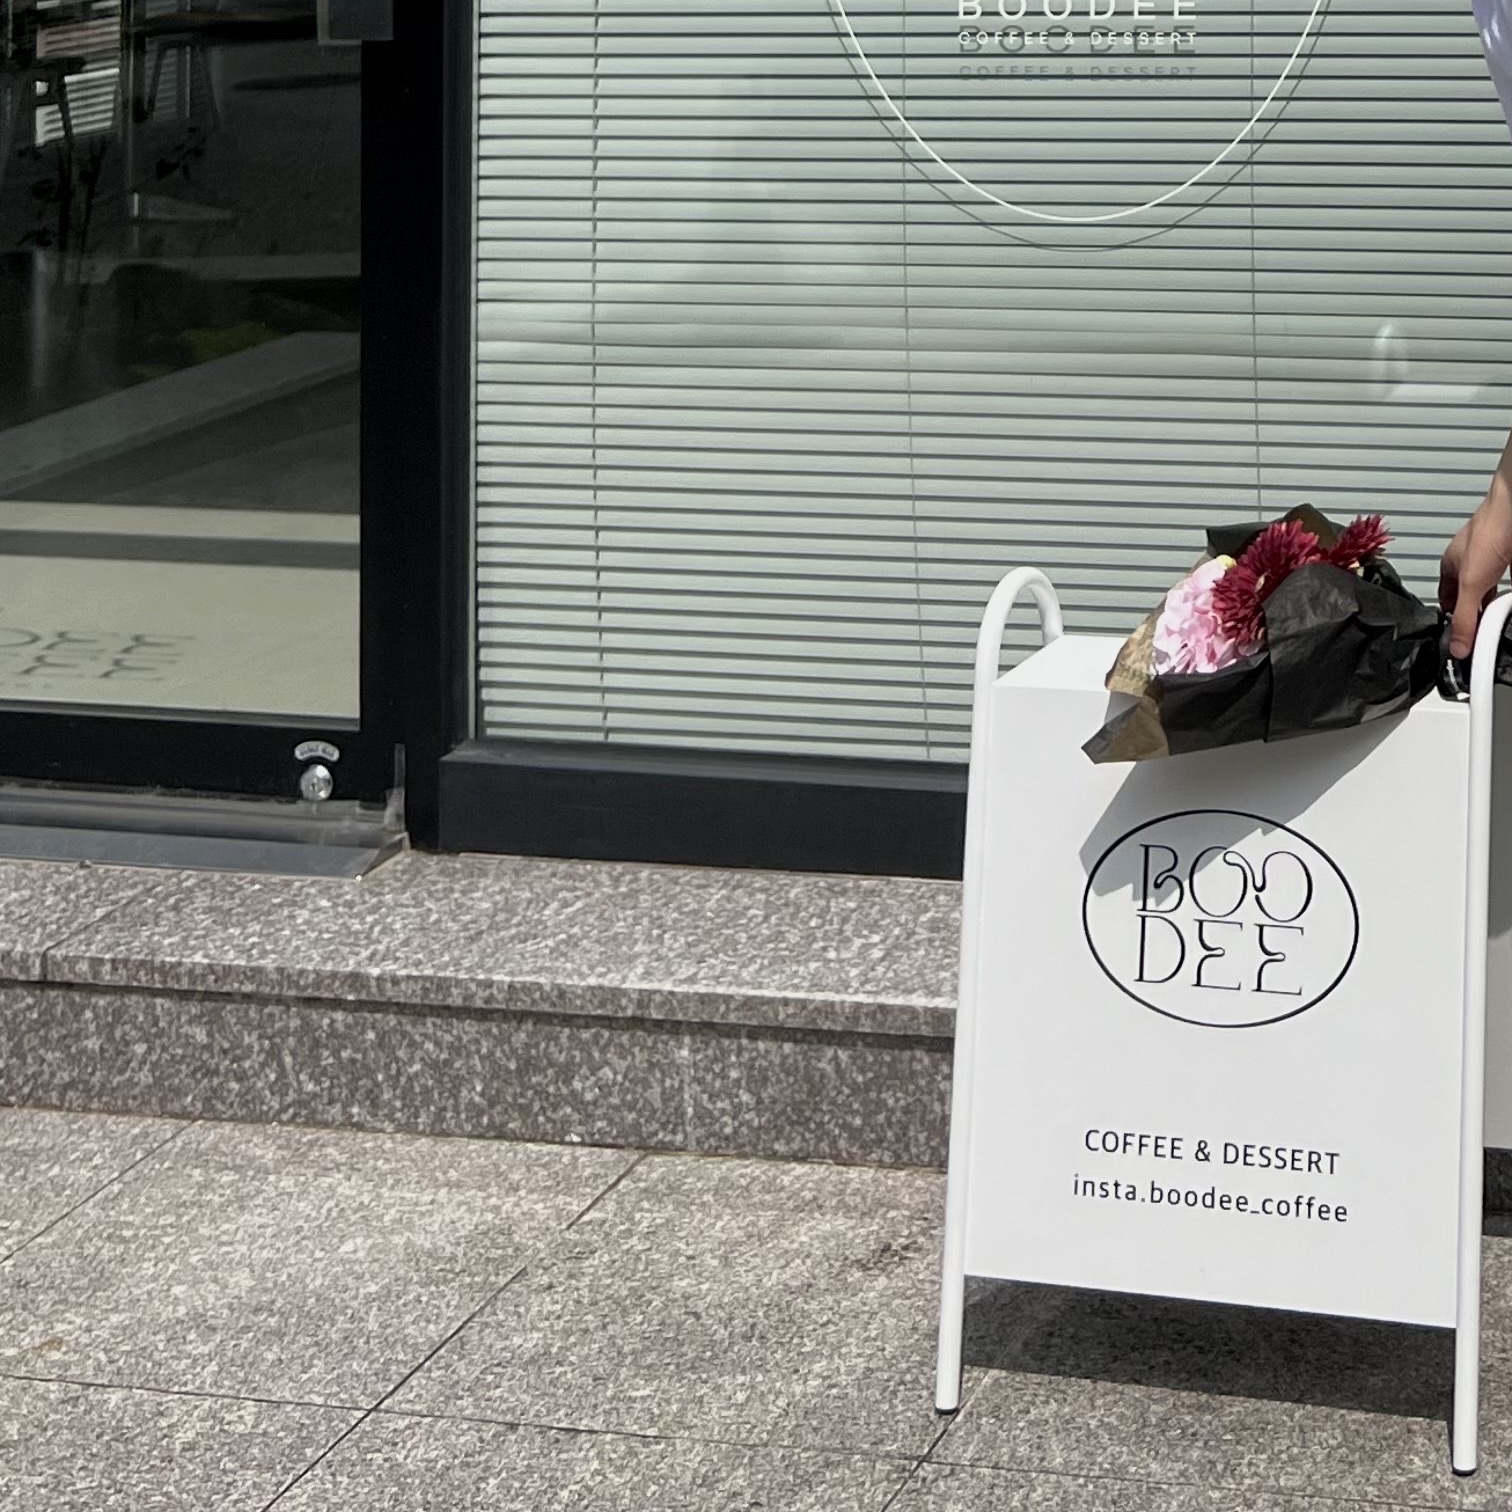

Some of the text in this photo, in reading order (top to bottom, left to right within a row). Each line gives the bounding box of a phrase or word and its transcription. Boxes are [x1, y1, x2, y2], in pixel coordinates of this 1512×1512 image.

[958, 30, 1197, 45] COFFEE & DESSERT
[1138, 843, 1314, 922] BOO
[1133, 913, 1305, 997] DEE
[1084, 1129, 1340, 1175] COFFEE & DESSERT
[1073, 1173, 1348, 1223] insta.boodee_coffee
